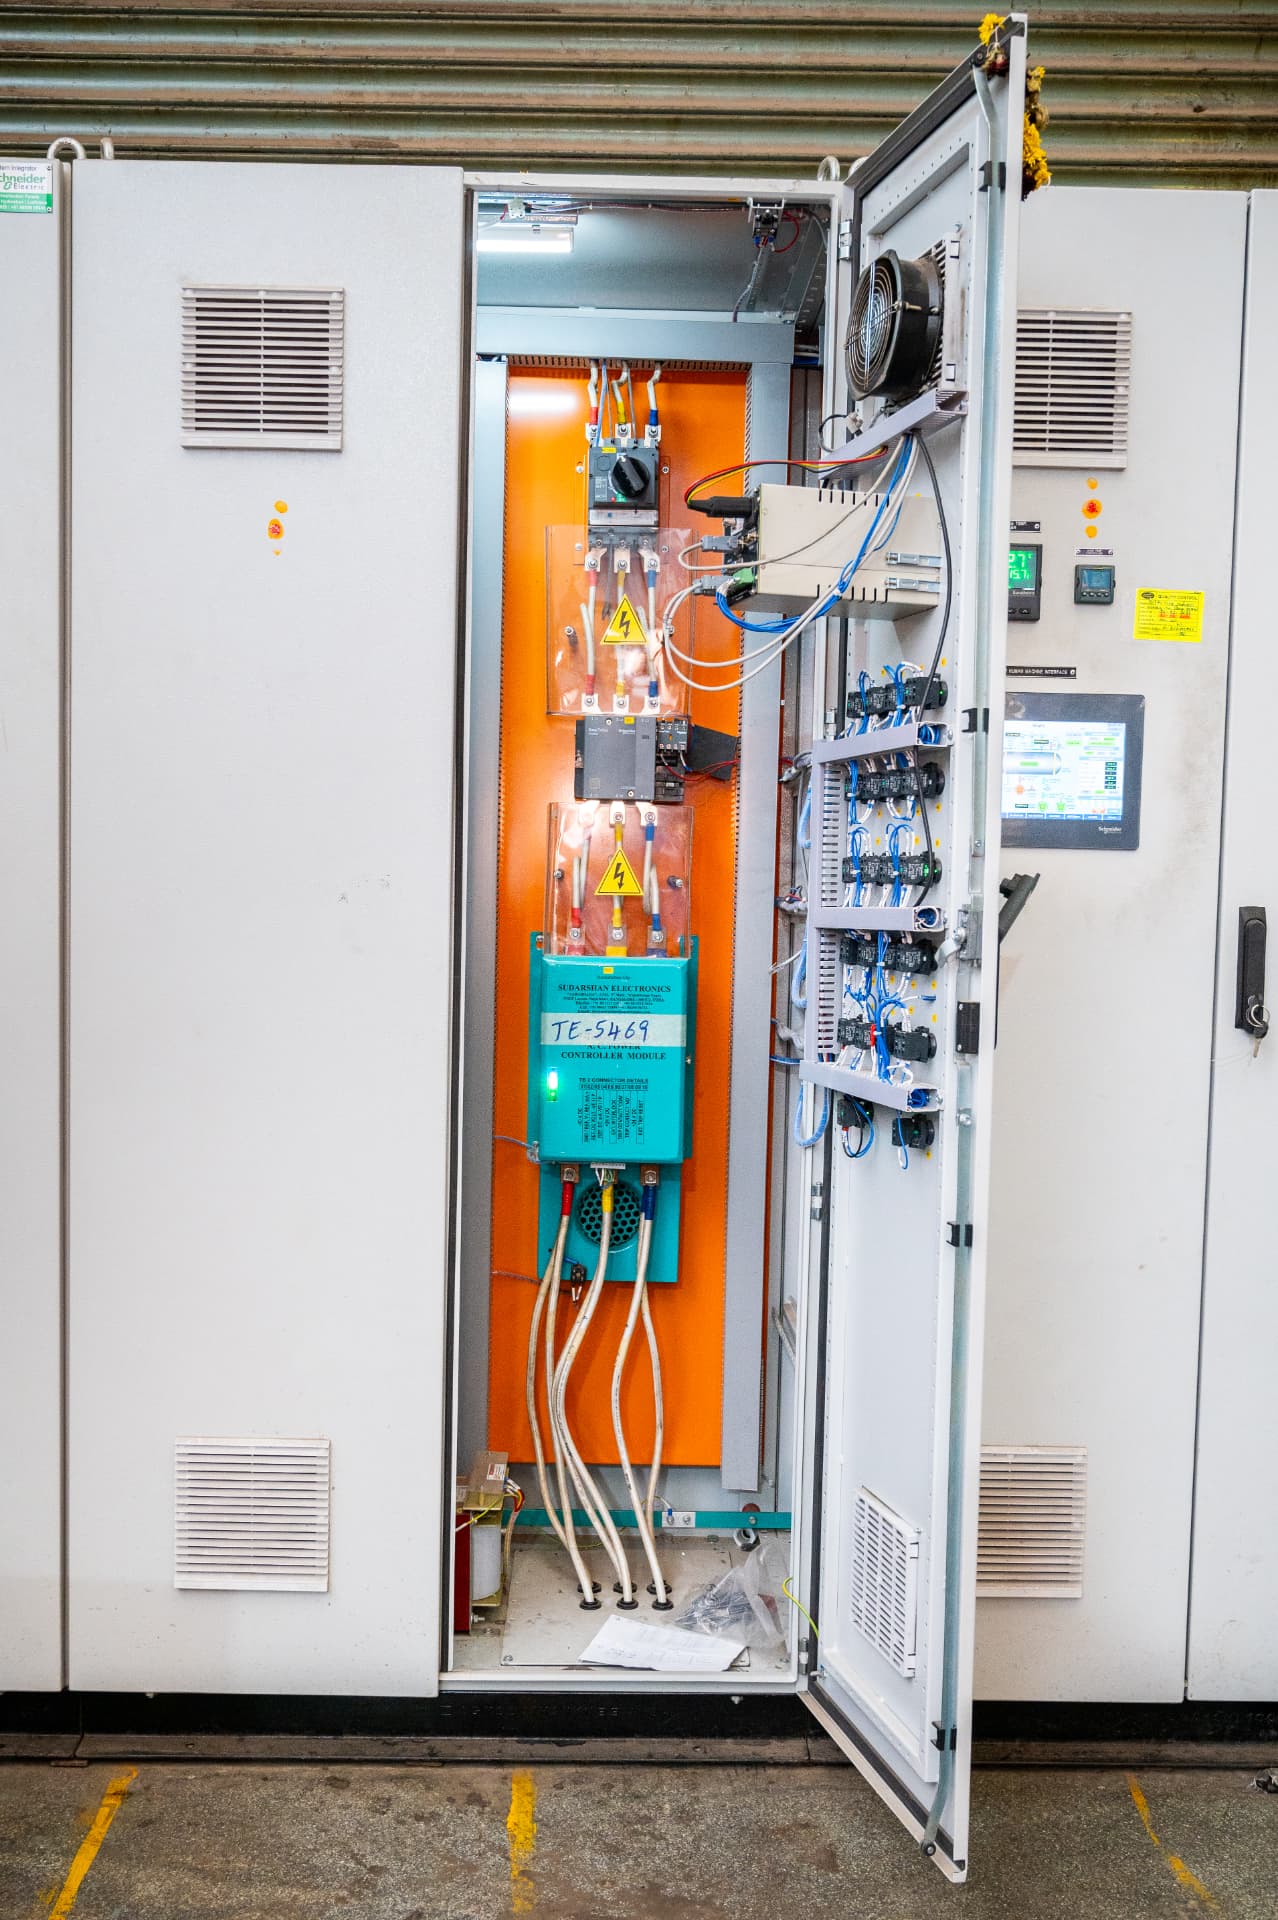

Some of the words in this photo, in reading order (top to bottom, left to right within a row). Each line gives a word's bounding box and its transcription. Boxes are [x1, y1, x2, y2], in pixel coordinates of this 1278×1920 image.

[0, 172, 46, 183] chneider
[558, 984, 609, 992] SUDARSHAN
[611, 985, 671, 993] ELECTRONICS
[552, 1019, 649, 1042] TE-5469
[561, 1051, 623, 1060] CONTROLLER
[627, 1052, 667, 1061] MODULE
